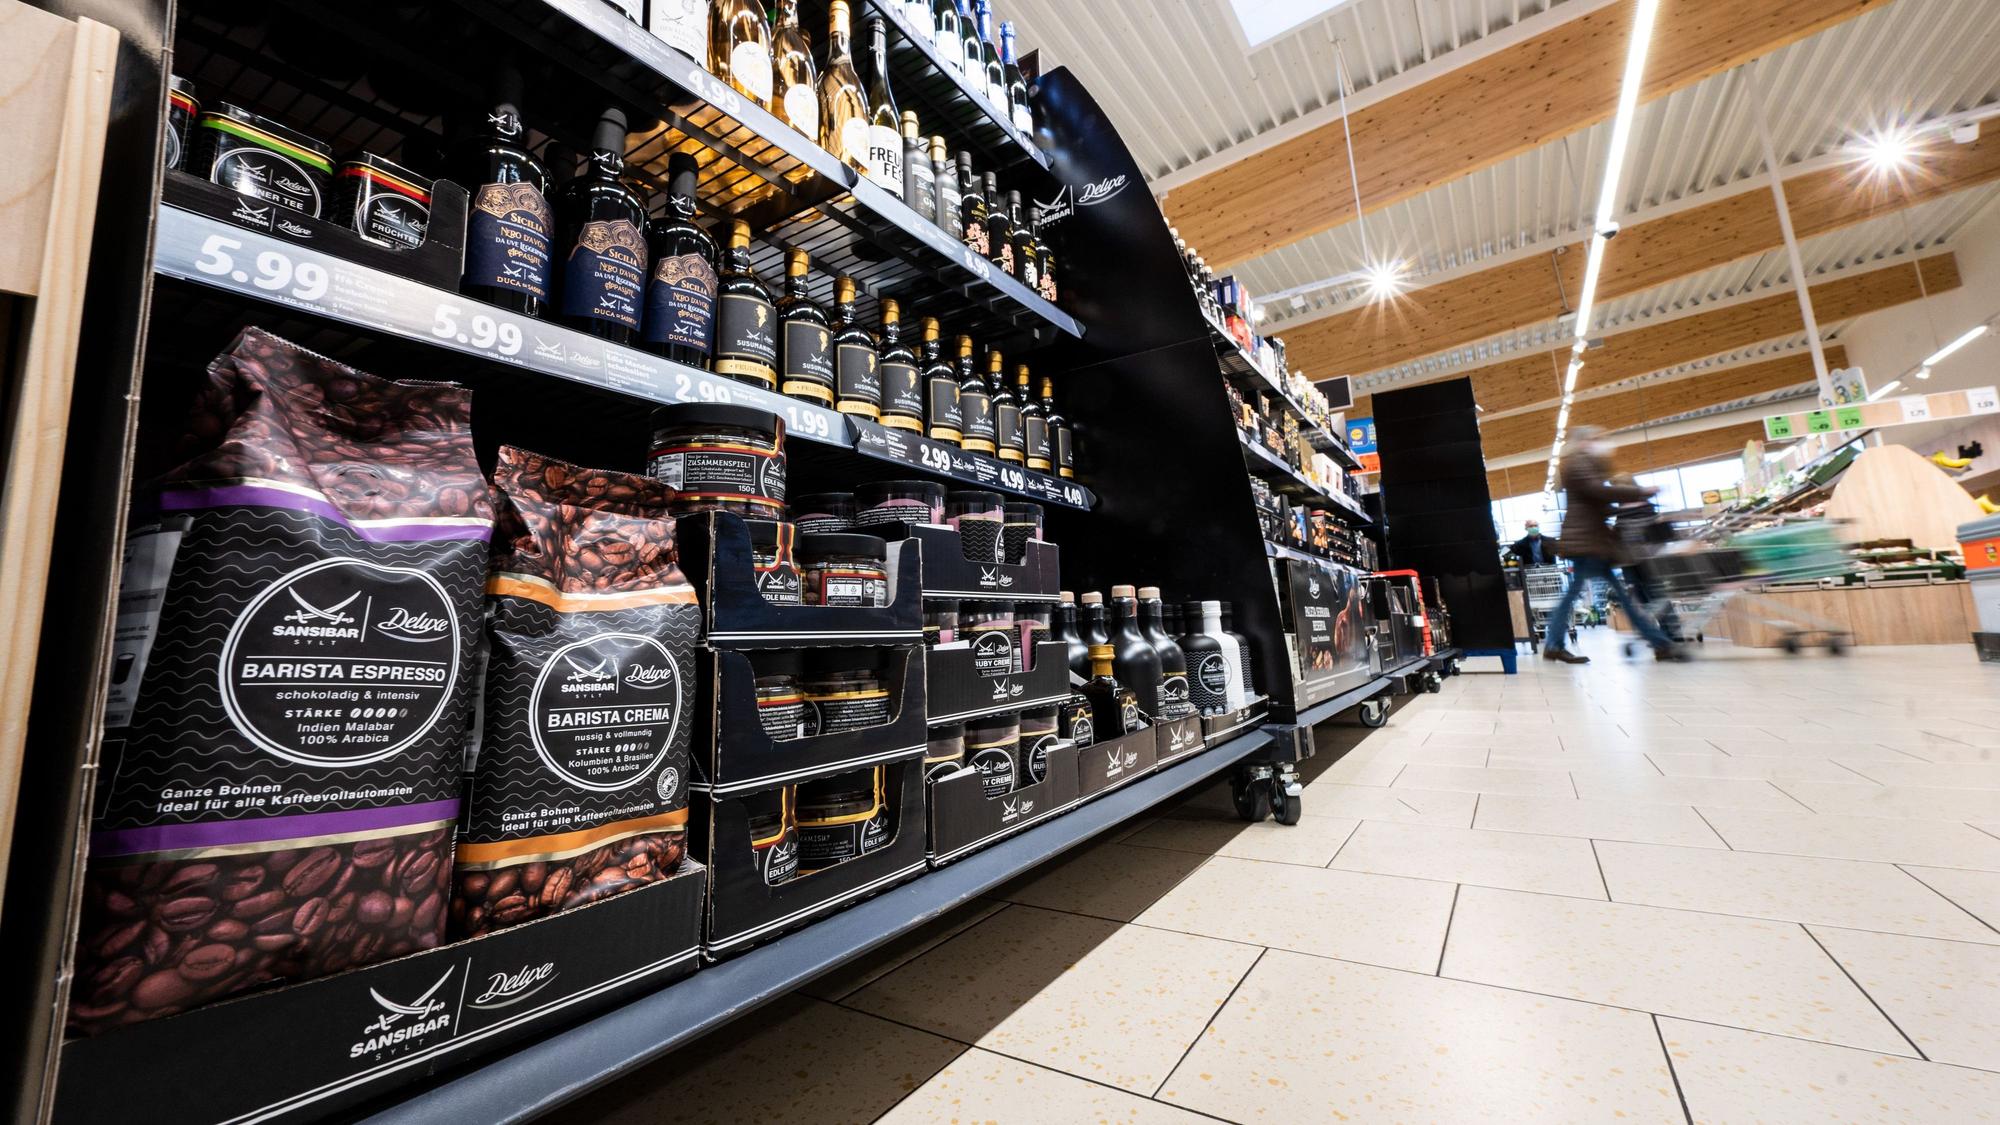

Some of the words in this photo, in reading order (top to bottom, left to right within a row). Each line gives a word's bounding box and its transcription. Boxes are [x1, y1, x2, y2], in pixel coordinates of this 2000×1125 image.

[869, 147, 901, 167] FREU
[282, 197, 304, 210] TEE
[1040, 208, 1071, 227] NSIBAR
[1078, 174, 1126, 203] Deluxe
[510, 212, 544, 233] SICILIA
[608, 248, 638, 267] SICILIA
[195, 234, 329, 301] 5.99
[496, 276, 521, 287] DUCA
[680, 280, 708, 296] SICILIA
[594, 307, 616, 318] DUCA
[431, 303, 523, 356] 5.99
[668, 333, 688, 343] DUCA
[787, 406, 828, 437] 1.99
[920, 443, 950, 472] 2.99
[1000, 467, 1024, 491] 4.99
[1064, 486, 1083, 506] 4.49
[272, 625, 360, 639] SANSIBAR
[376, 606, 450, 635] Deluxe
[241, 663, 345, 679] BARISTA
[350, 665, 447, 682] ESPRESSO
[561, 682, 616, 693] SANSIBAR
[625, 663, 672, 684] Deluxe
[275, 690, 360, 701] schokoladig
[363, 690, 373, 700] &
[376, 691, 420, 700] intensiv
[284, 707, 343, 719] STÄRKE
[547, 710, 621, 728] BARISTA
[624, 707, 670, 721] CREMA
[297, 722, 341, 733] Indien
[344, 721, 396, 732] Malabar
[574, 732, 603, 742] nussig
[613, 729, 653, 739] vollmundig
[300, 734, 338, 745] 100%
[341, 734, 390, 744] Arabica
[568, 757, 614, 769] Kolumbien
[615, 755, 622, 763] &
[623, 752, 654, 763] Brasilien
[575, 746, 611, 756] STÄRKE
[586, 766, 610, 776] 100%
[611, 763, 640, 773] Arabica
[156, 800, 199, 813] Ideal
[204, 797, 230, 810] für
[234, 796, 266, 809] alle
[271, 785, 414, 806] Kaffeevollautomaten
[160, 786, 213, 799] Ganze
[218, 783, 283, 796] Bohnen
[501, 821, 529, 832] Ideal
[532, 817, 550, 829] für
[552, 815, 572, 826] alle
[574, 802, 655, 824] Kaffeevollautomaten
[502, 810, 538, 822] Ganze
[540, 804, 581, 817] Bohnen
[769, 865, 784, 878] EDLE
[349, 1014, 450, 1059] SANSIBAR
[474, 961, 555, 1004] Deluxe
